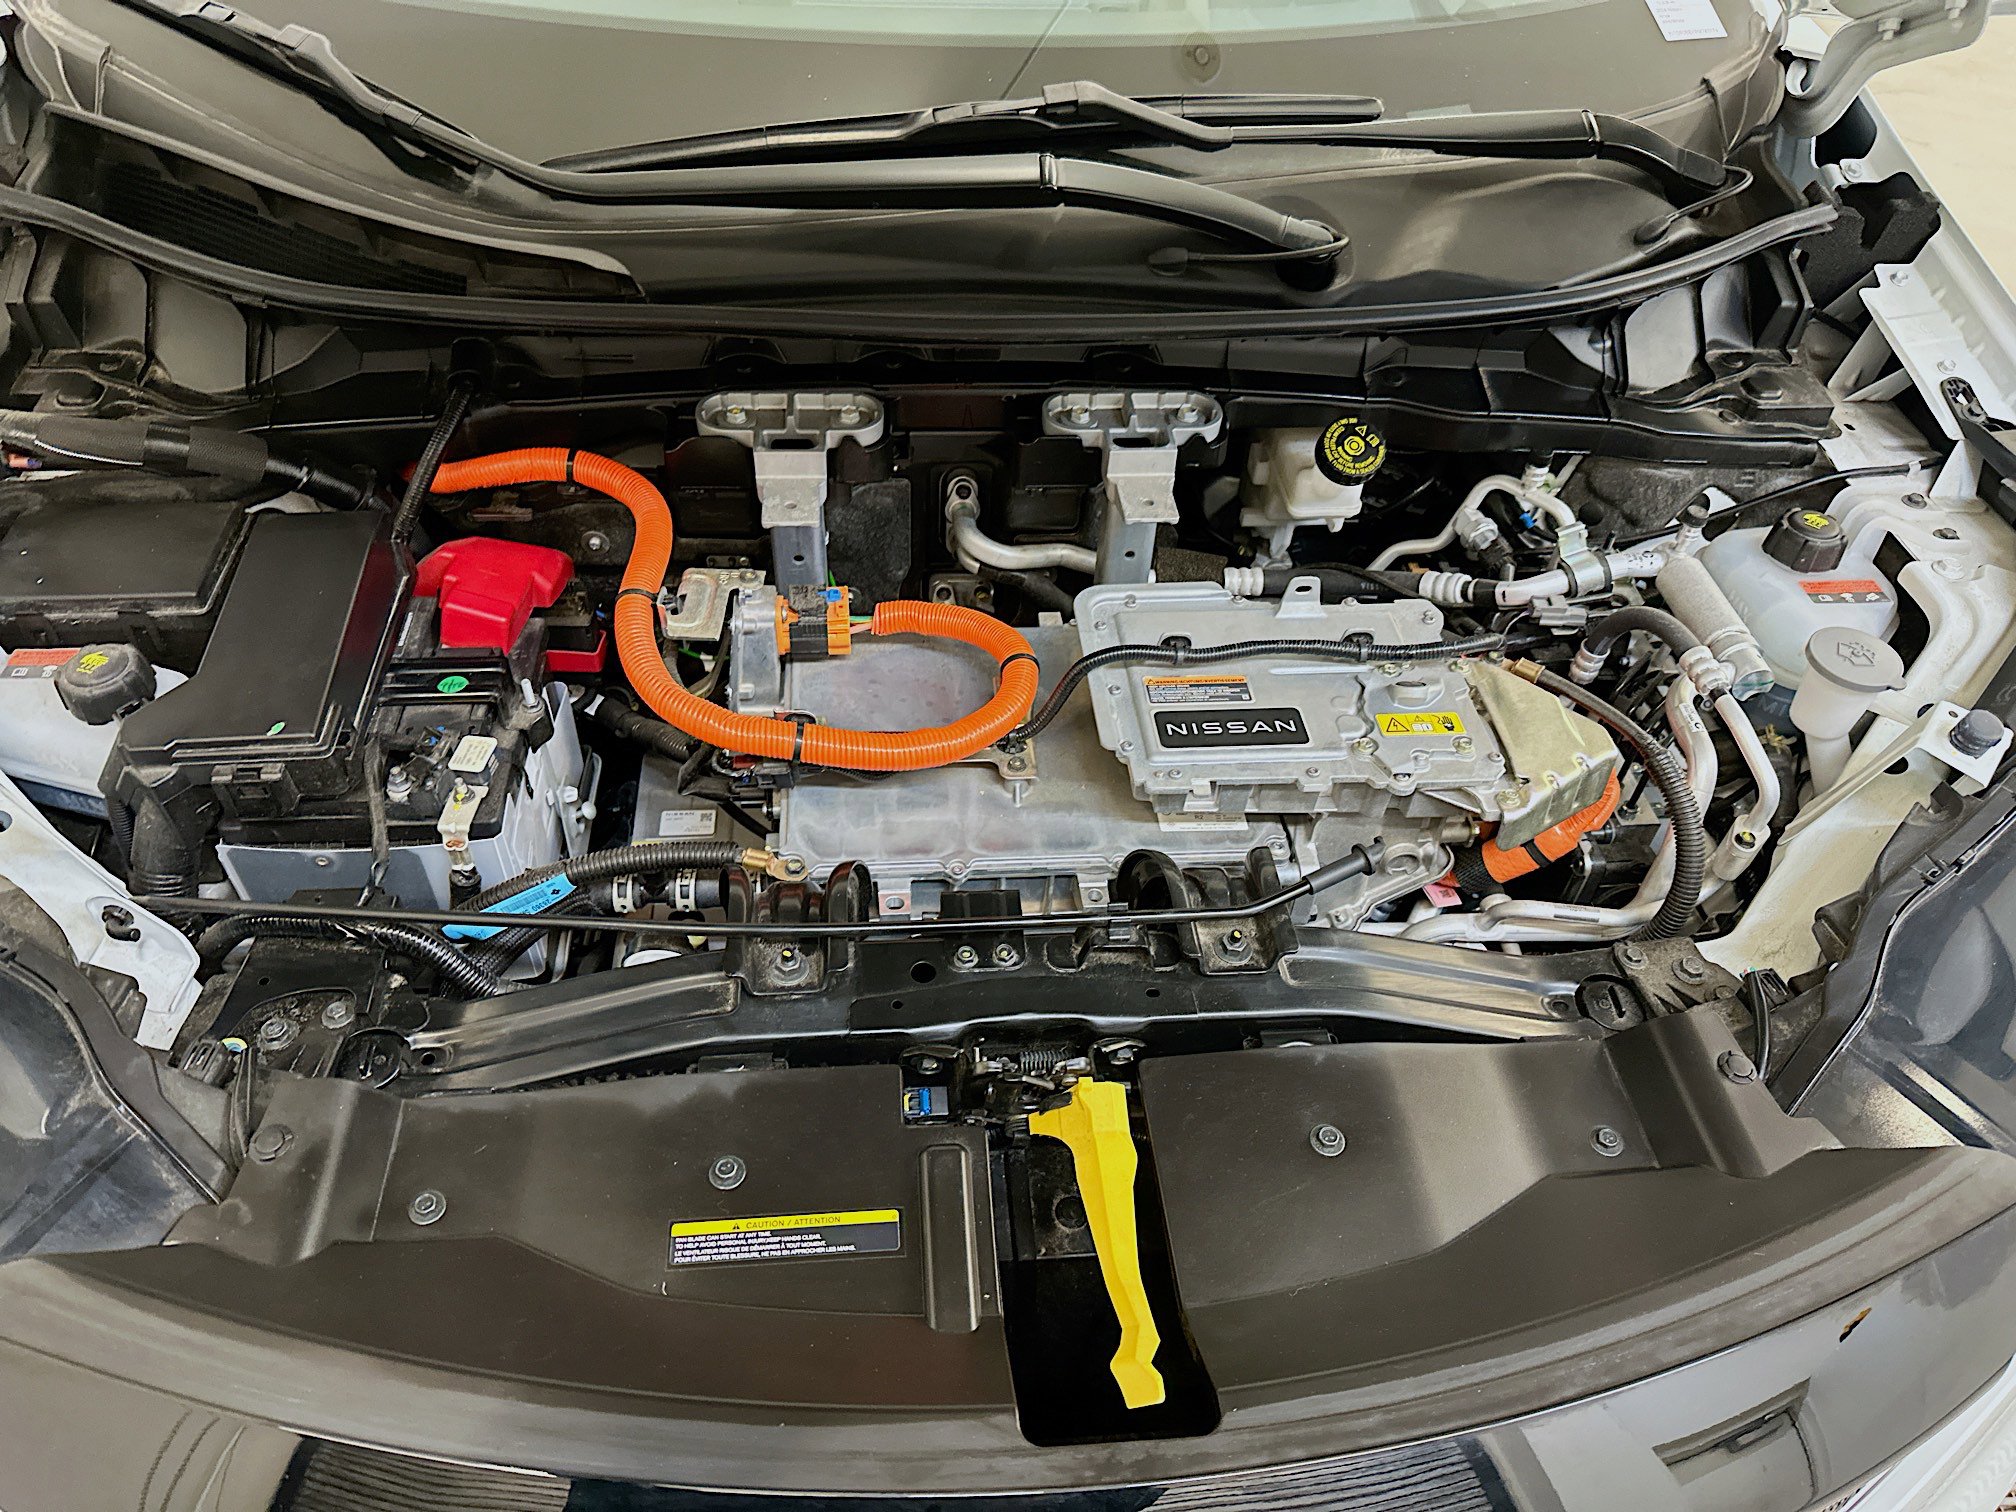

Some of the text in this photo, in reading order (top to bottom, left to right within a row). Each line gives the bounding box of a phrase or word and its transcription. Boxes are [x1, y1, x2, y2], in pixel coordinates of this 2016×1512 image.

[1332, 450, 1340, 459] CAP
[1166, 720, 1297, 736] NISSAN
[746, 1220, 784, 1229] CAUTION
[794, 1216, 840, 1226] ATTENTION
